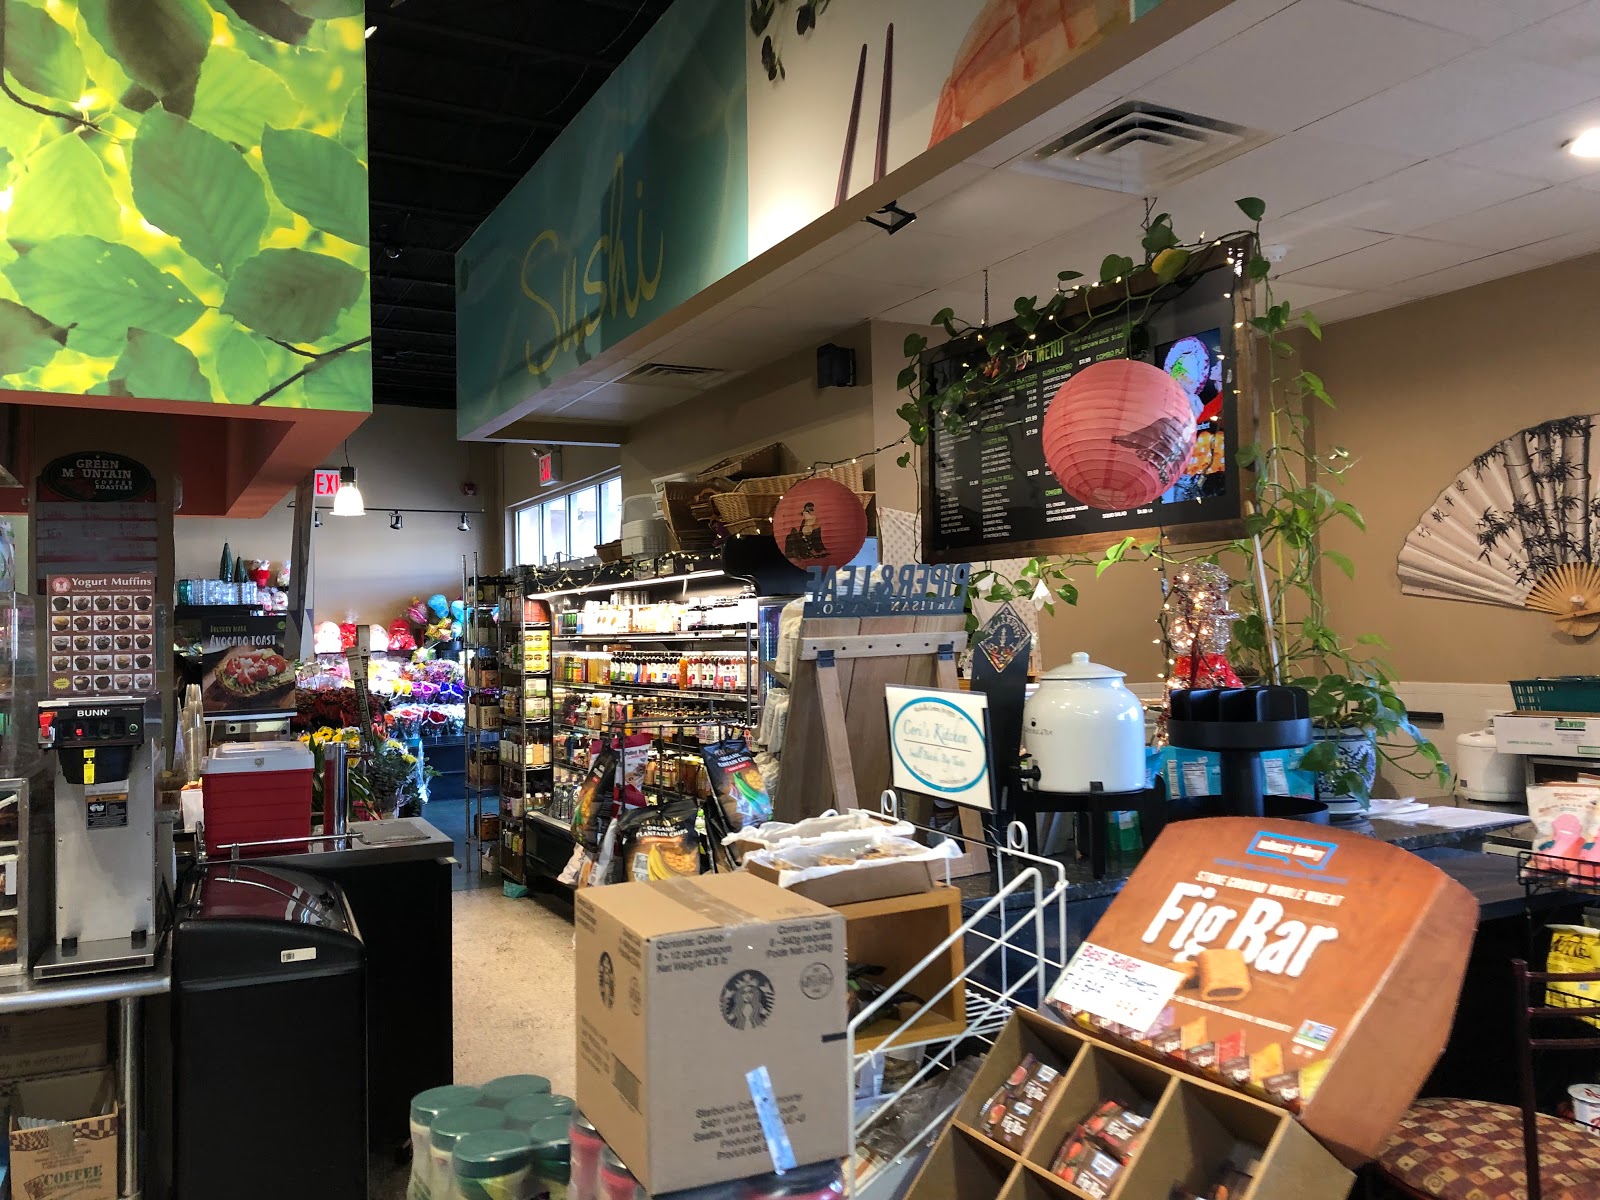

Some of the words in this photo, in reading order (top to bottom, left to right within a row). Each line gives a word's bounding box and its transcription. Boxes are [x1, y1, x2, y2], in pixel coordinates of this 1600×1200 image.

[521, 153, 664, 375] Sushi
[1036, 340, 1064, 363] MENU
[76, 459, 119, 469] GREEN
[62, 468, 131, 479] MUNTAIN
[316, 473, 339, 495] EXI
[71, 577, 107, 588] Yogurt
[111, 576, 152, 586] Muffins
[210, 634, 249, 647] AVOCADO
[250, 634, 277, 646] TOAST
[77, 709, 109, 717] BUNN
[668, 828, 688, 837] CHIPS
[1195, 870, 1229, 886] STONE
[1225, 876, 1269, 894] GROUND
[1266, 884, 1307, 901] WHOLE
[1303, 890, 1346, 907] WHEAT
[1141, 882, 1237, 963] Fig
[1225, 897, 1339, 977] Bar
[697, 934, 724, 945] Coffee
[1082, 945, 1109, 961] Best
[1108, 954, 1141, 972] Seller
[43, 1165, 102, 1186] COFFEE
